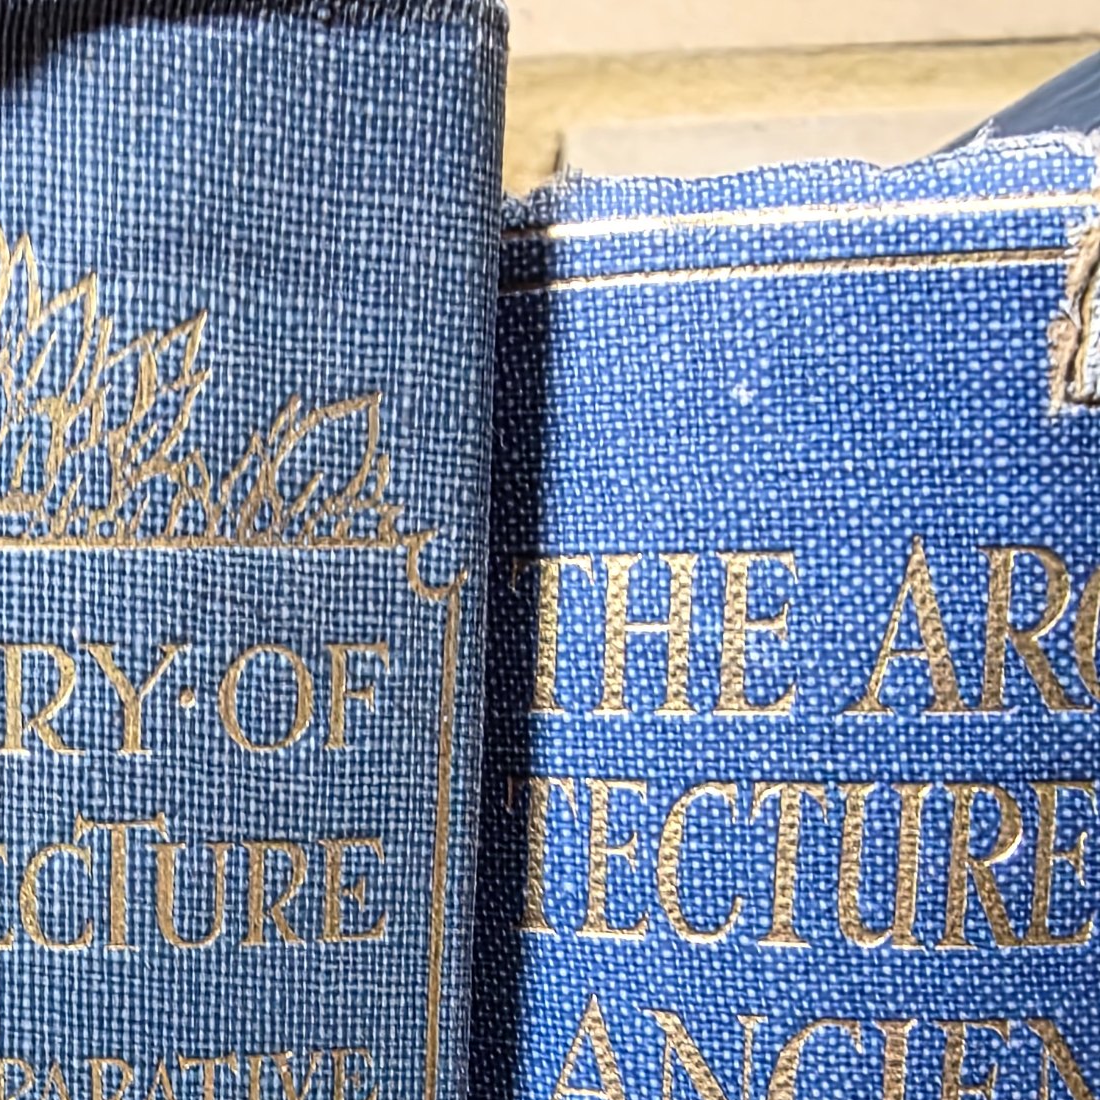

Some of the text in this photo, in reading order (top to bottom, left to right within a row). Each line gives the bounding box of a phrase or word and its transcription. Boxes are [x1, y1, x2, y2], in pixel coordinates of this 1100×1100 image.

[509, 535, 1100, 718] THE AR
[507, 776, 1099, 951] TECTURE
